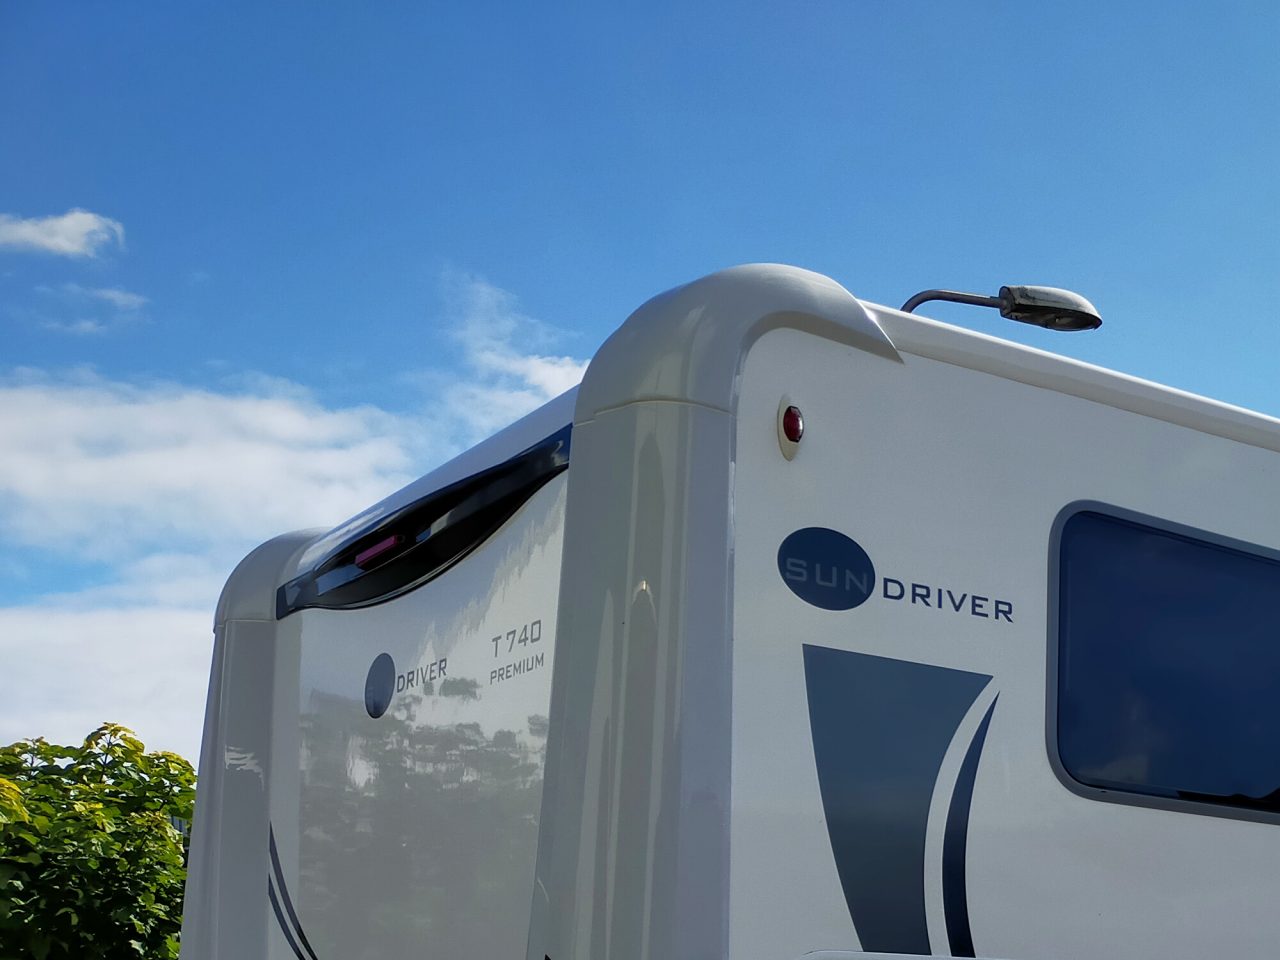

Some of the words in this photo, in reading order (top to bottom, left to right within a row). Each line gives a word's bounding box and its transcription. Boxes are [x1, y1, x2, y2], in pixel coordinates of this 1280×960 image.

[785, 557, 868, 595] SUN
[882, 577, 1014, 623] DRIVER
[491, 635, 503, 658] T
[506, 619, 542, 653] 740
[396, 657, 448, 694] DRIVER
[490, 652, 545, 686] PREMIUM
